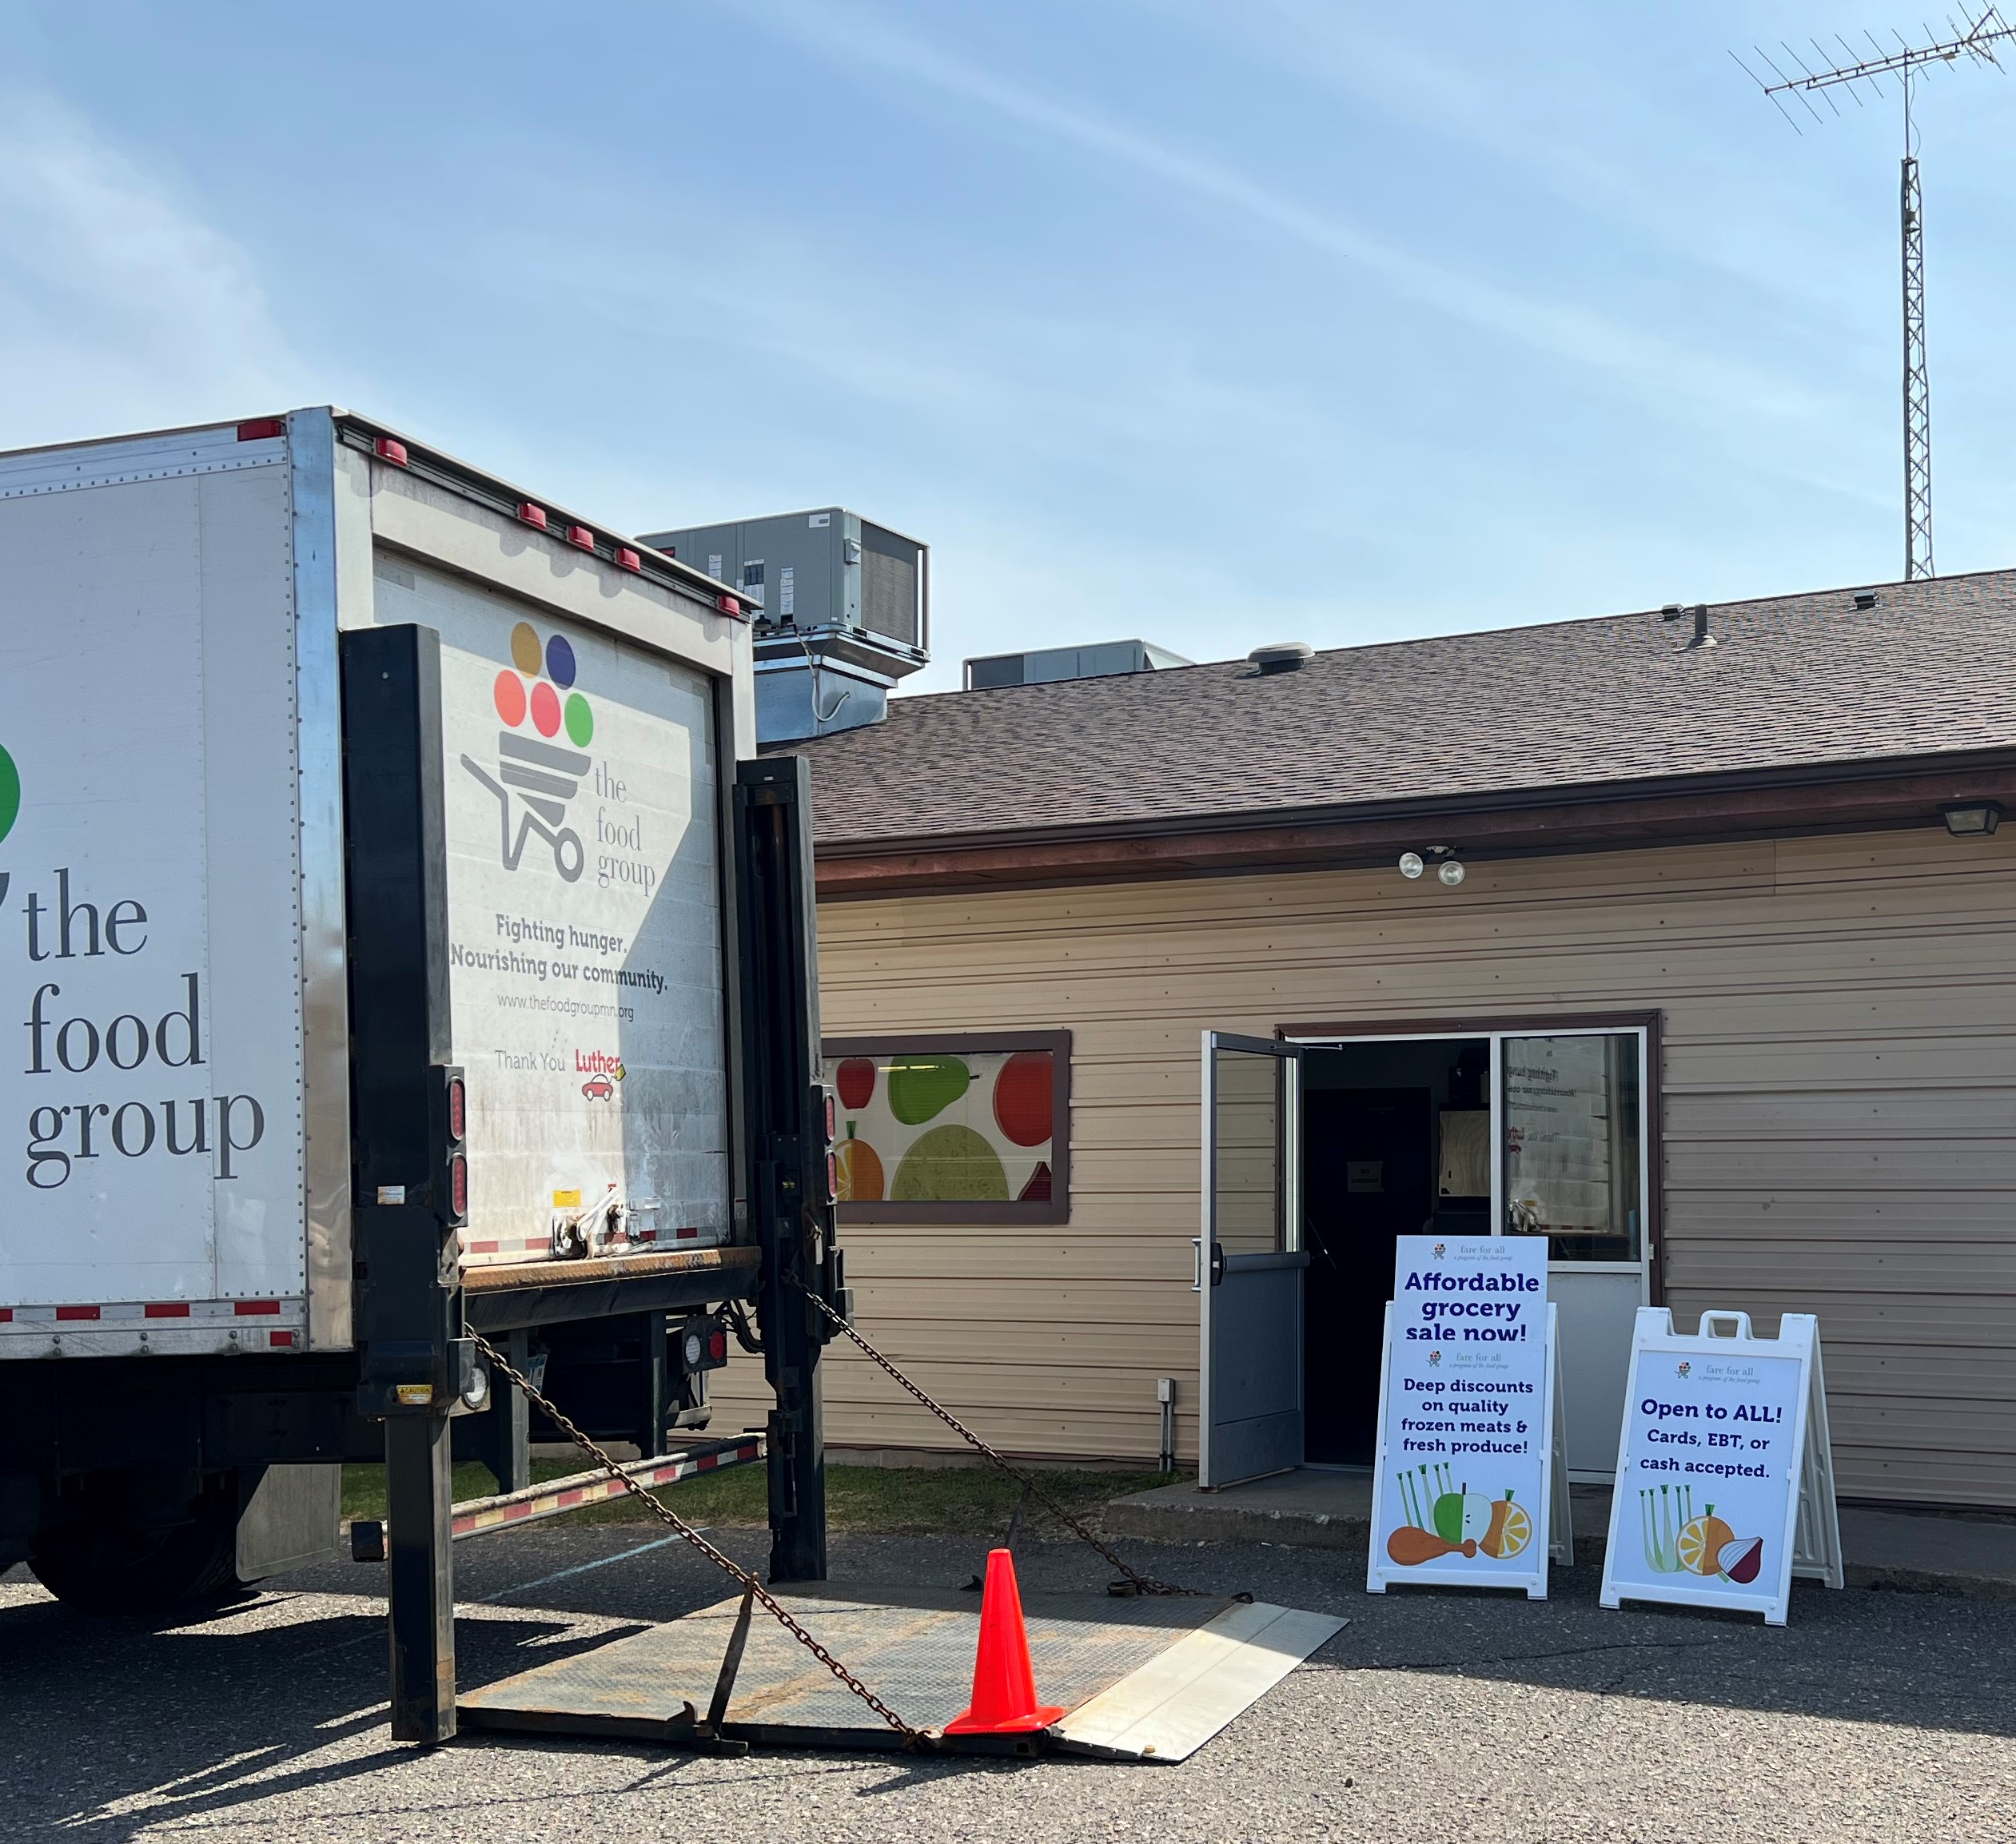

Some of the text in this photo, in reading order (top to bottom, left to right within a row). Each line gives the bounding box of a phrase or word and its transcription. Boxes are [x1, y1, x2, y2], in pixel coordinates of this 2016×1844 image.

[595, 761, 627, 803] the
[597, 807, 641, 852] food
[598, 855, 655, 898] group
[22, 867, 148, 962] the
[496, 914, 628, 956] Fighting hunger.
[451, 943, 668, 995] Nourishing our community.
[496, 994, 635, 1023] www.thefoodgroupmn.org
[23, 972, 207, 1074] food
[494, 1049, 621, 1074] Thank You Luther
[26, 1094, 265, 1189] group
[1404, 1272, 1540, 1292] Affordable
[1421, 1301, 1521, 1322] grocery
[1405, 1323, 1527, 1342] sale now!
[1456, 1352, 1501, 1362] fare for all
[1707, 1365, 1754, 1376] fare for all
[1404, 1378, 1533, 1395] Deep discounts
[1421, 1400, 1509, 1416] on quality
[1641, 1399, 1782, 1424] Open to ALL!
[1401, 1418, 1528, 1433] frozen meats &
[1403, 1438, 1528, 1455] fresh produce!
[1647, 1428, 1770, 1450] Cards, EBT, or
[1640, 1457, 1770, 1478] cash accepted.
